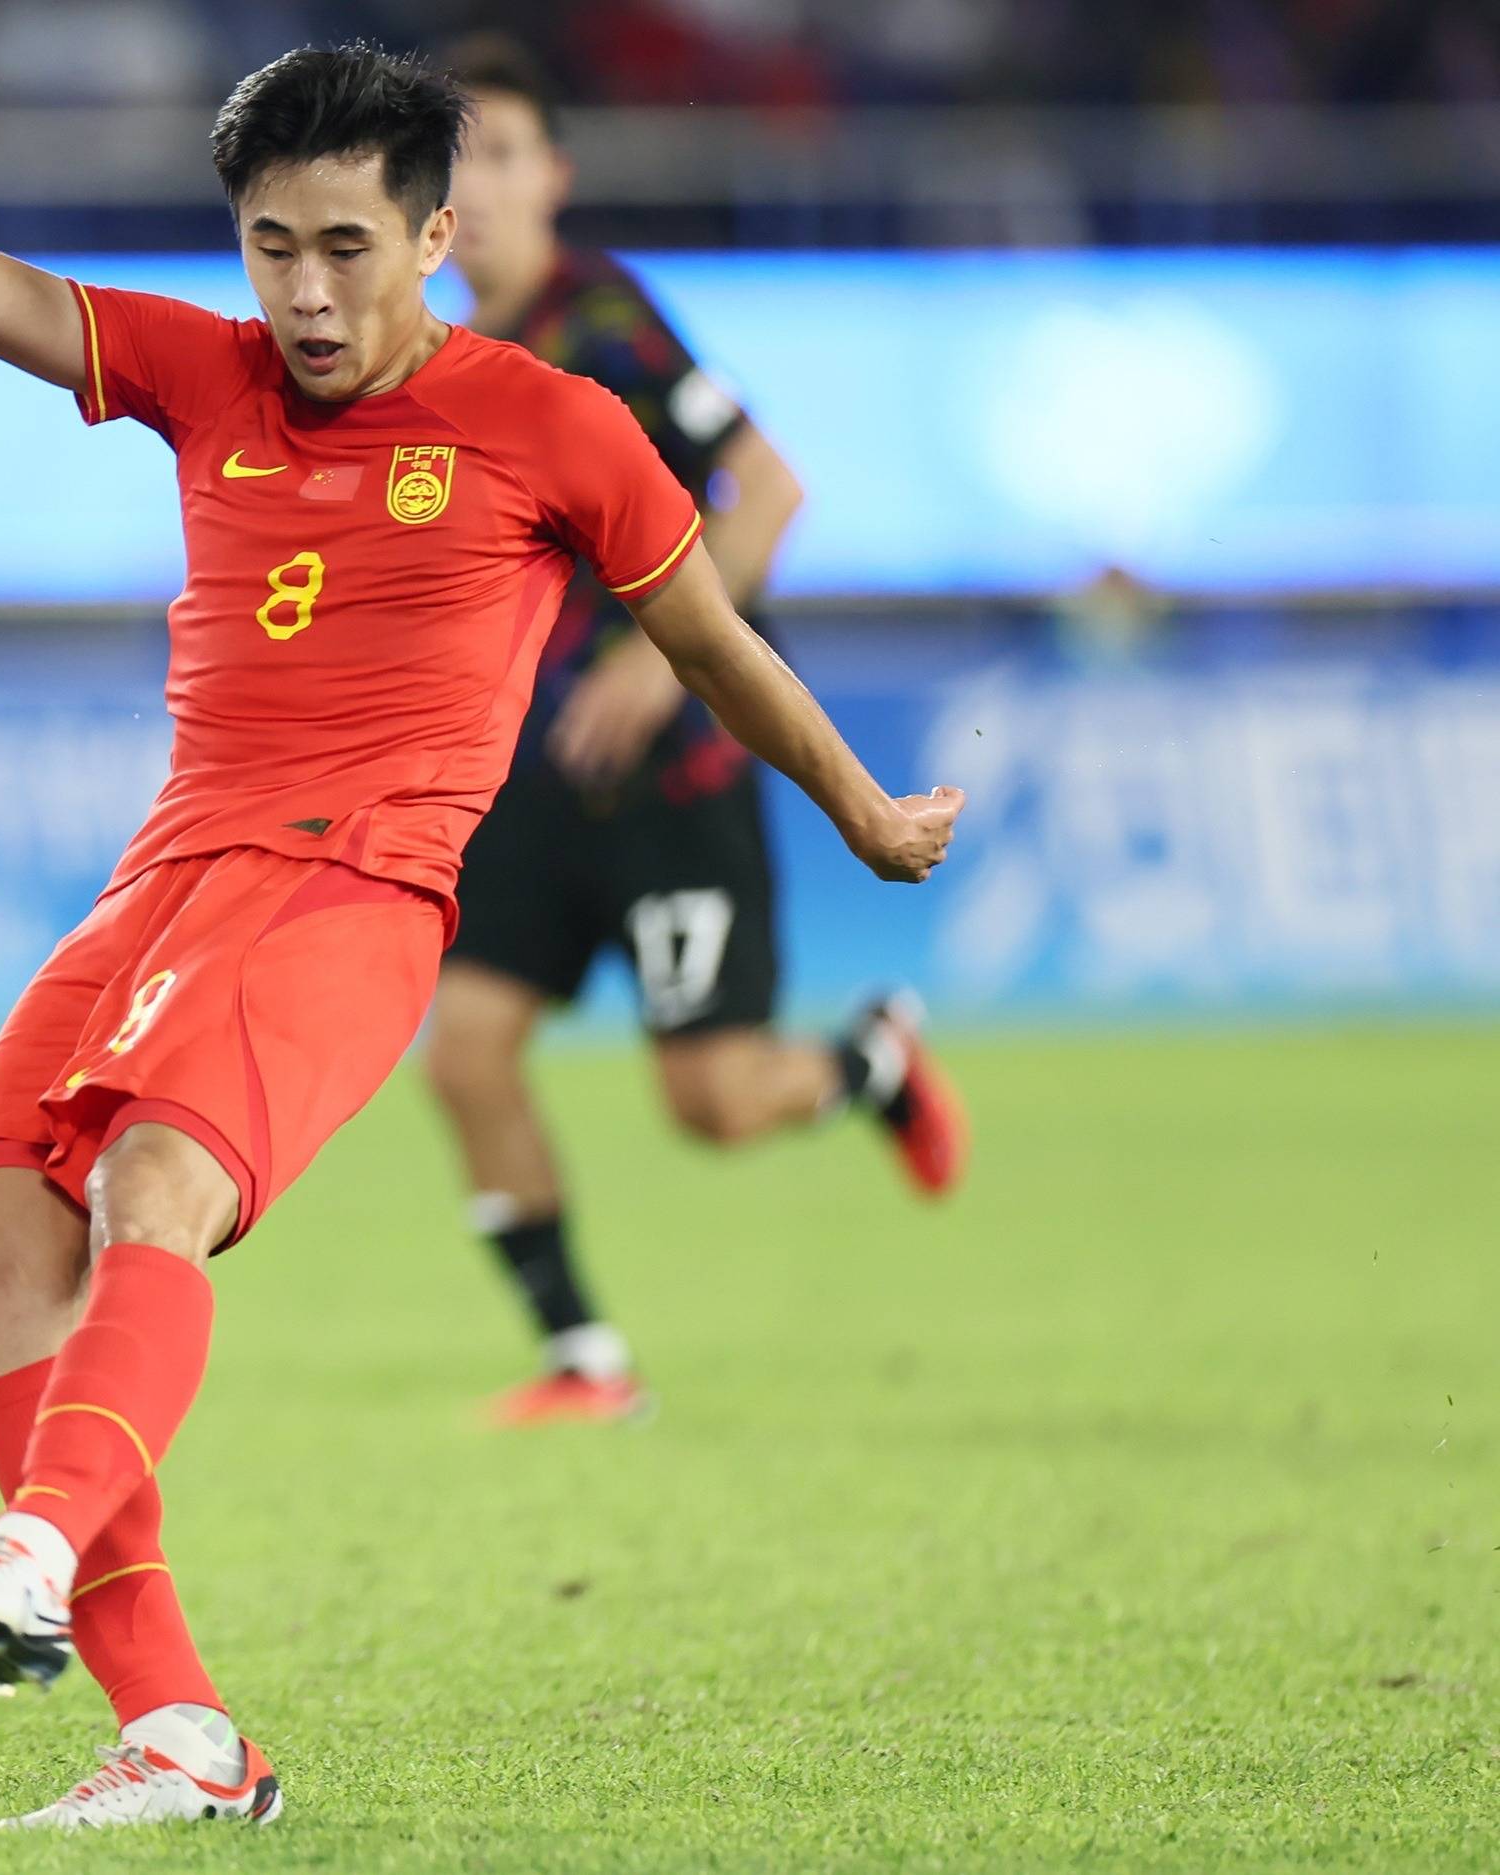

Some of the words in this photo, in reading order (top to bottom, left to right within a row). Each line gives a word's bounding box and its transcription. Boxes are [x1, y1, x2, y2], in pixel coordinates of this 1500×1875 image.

[398, 446, 450, 461] CFA
[256, 551, 325, 640] 8
[626, 887, 735, 1028] 17
[107, 969, 177, 1053] 8
